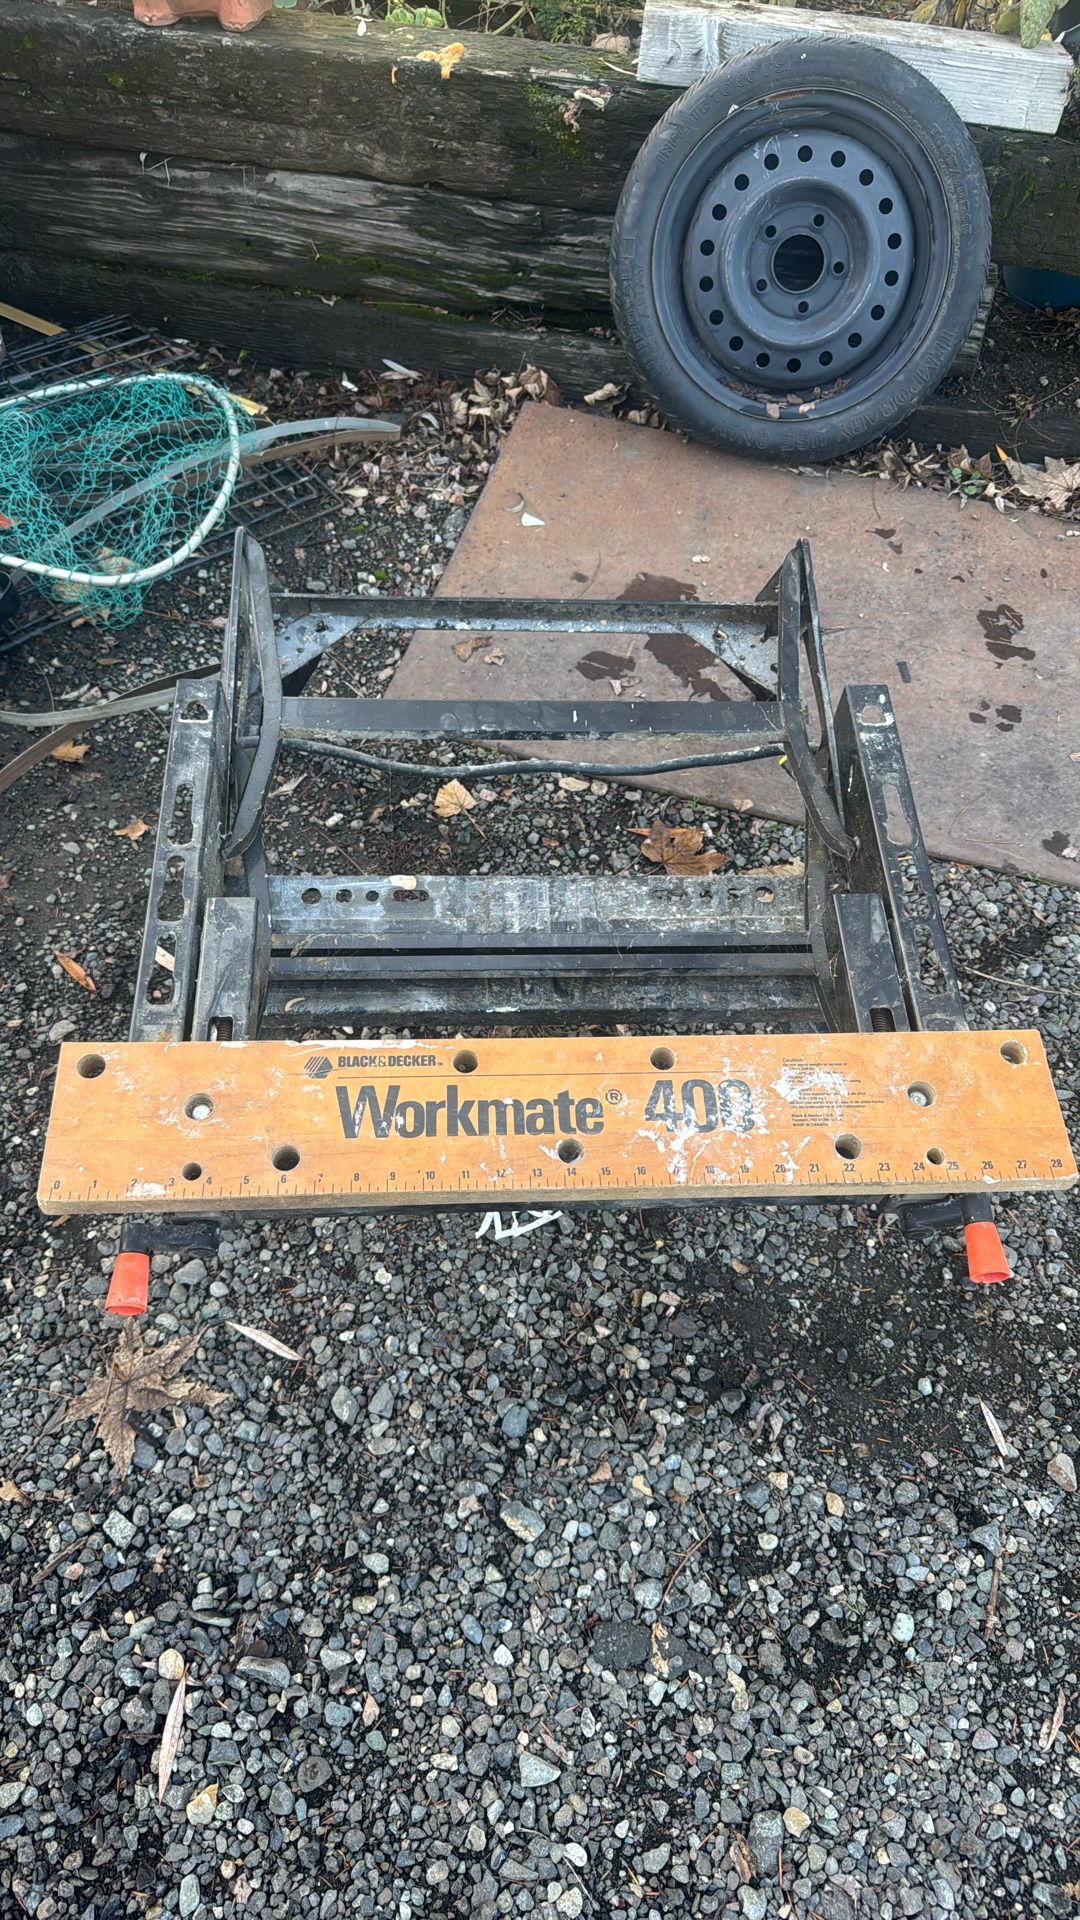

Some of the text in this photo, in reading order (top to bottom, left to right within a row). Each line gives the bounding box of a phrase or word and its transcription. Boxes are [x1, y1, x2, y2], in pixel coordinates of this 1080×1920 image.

[839, 328, 955, 439] TEMPORARY
[781, 428, 828, 451] USE
[54, 1180, 60, 1189] 0
[92, 1180, 97, 1188] 1
[131, 1178, 138, 1187] 2
[168, 1178, 175, 1187] 3
[206, 1177, 212, 1185] 4
[243, 1176, 250, 1185] 5
[280, 1175, 287, 1183] 6
[317, 1174, 323, 1182] 7
[354, 1173, 360, 1181] 8
[390, 1172, 396, 1180] 9
[425, 1171, 435, 1179] 10
[462, 1170, 470, 1179] 11
[496, 1169, 506, 1178] 12
[533, 1169, 543, 1177] 13
[567, 1168, 577, 1176] 14
[601, 1167, 611, 1175] 15
[637, 1167, 646, 1175] 16
[740, 1165, 750, 1173] 19
[775, 1164, 787, 1173] 20
[810, 1164, 819, 1172] 21
[844, 1163, 855, 1172] 22
[879, 1163, 890, 1171] 23
[913, 1162, 925, 1171] 24
[948, 1162, 958, 1170] 25
[982, 1161, 993, 1169] 26
[1016, 1160, 1027, 1169] 27
[1050, 1159, 1062, 1168] 28
